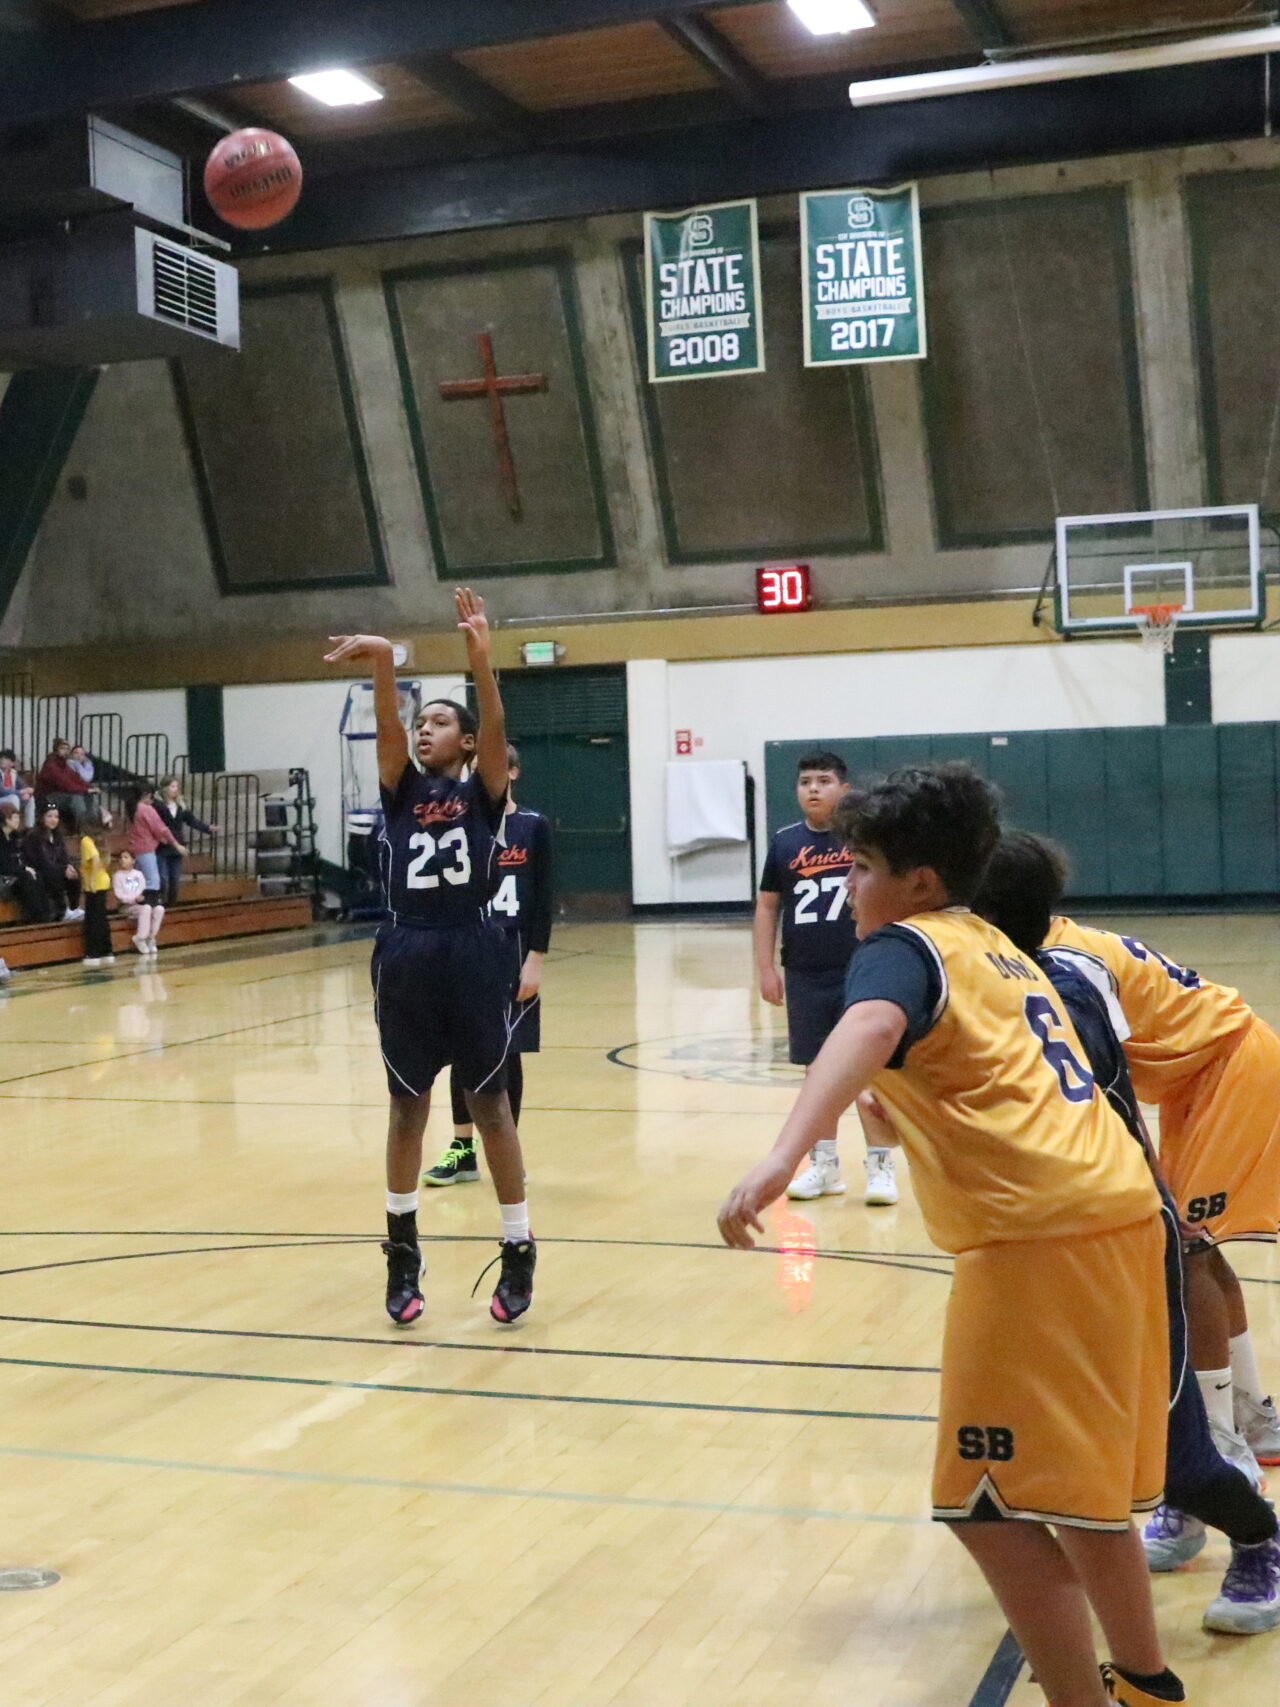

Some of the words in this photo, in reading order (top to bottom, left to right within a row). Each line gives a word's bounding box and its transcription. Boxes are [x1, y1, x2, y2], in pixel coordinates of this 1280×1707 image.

[847, 197, 875, 229] S
[660, 253, 744, 298] STATE
[816, 237, 905, 280] STATE
[661, 290, 746, 319] CHAMPIONS
[817, 275, 906, 302] CHAMPIONS
[825, 306, 847, 316] BOYS
[851, 303, 903, 314] BASKETBALL
[669, 333, 739, 367] 2008
[831, 318, 895, 351] 2017
[762, 570, 803, 607] 30
[407, 827, 471, 889] 23
[789, 845, 855, 870] Knick
[793, 876, 849, 925] 27
[1023, 993, 1095, 1104] 6
[1187, 1191, 1228, 1223] SB
[957, 1426, 1014, 1461] SB
